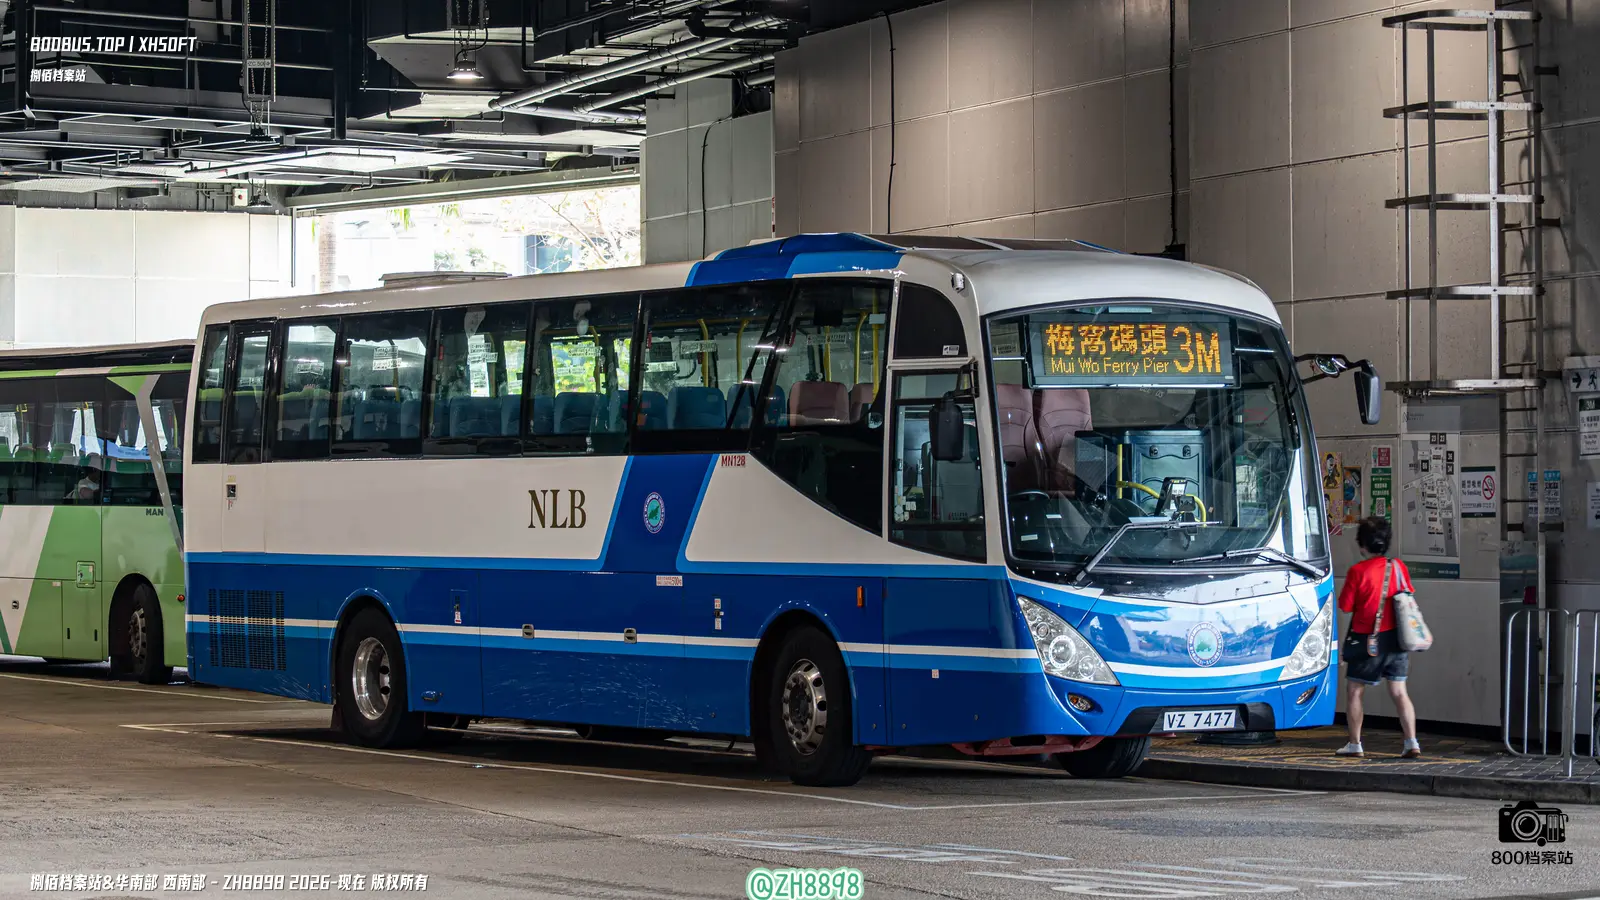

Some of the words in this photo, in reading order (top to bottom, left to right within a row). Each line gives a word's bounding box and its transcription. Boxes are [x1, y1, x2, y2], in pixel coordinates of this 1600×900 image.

[1046, 324, 1169, 356] 梅窩碼頭
[1172, 326, 1221, 373] 3M
[1051, 357, 1075, 374] Mui
[1077, 357, 1100, 374] Wo
[1103, 357, 1139, 376] Ferry
[1143, 357, 1169, 374] Pier
[721, 455, 746, 467] MN128
[145, 507, 164, 516] MAN
[528, 489, 587, 529] NLB
[1167, 713, 1186, 728] VZ
[1193, 712, 1233, 728] 7477
